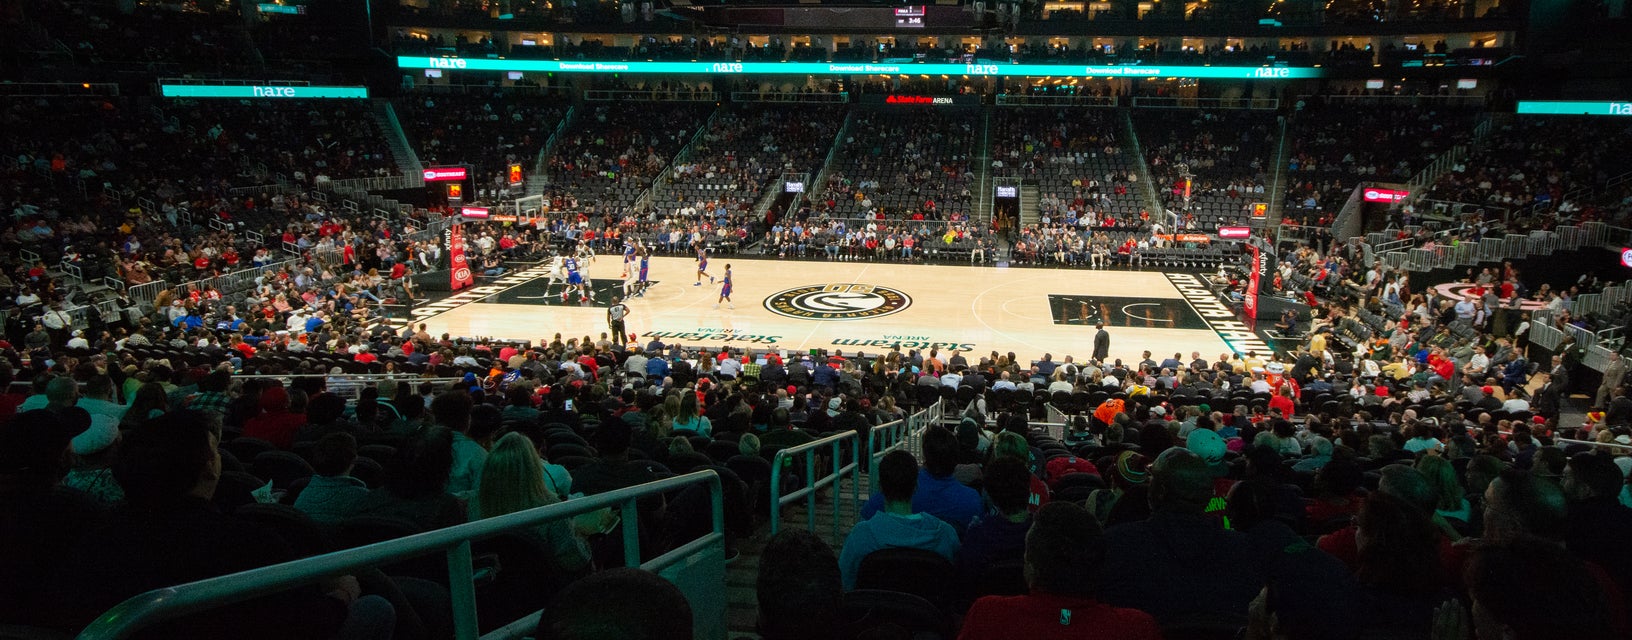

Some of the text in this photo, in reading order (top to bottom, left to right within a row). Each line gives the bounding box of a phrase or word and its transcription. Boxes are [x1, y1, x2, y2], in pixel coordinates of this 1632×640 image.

[829, 64, 863, 72] Download
[1085, 67, 1122, 75] Download
[1259, 252, 1269, 276] xfinity
[1165, 273, 1236, 317] ATLANTA
[697, 327, 742, 335] ARENA
